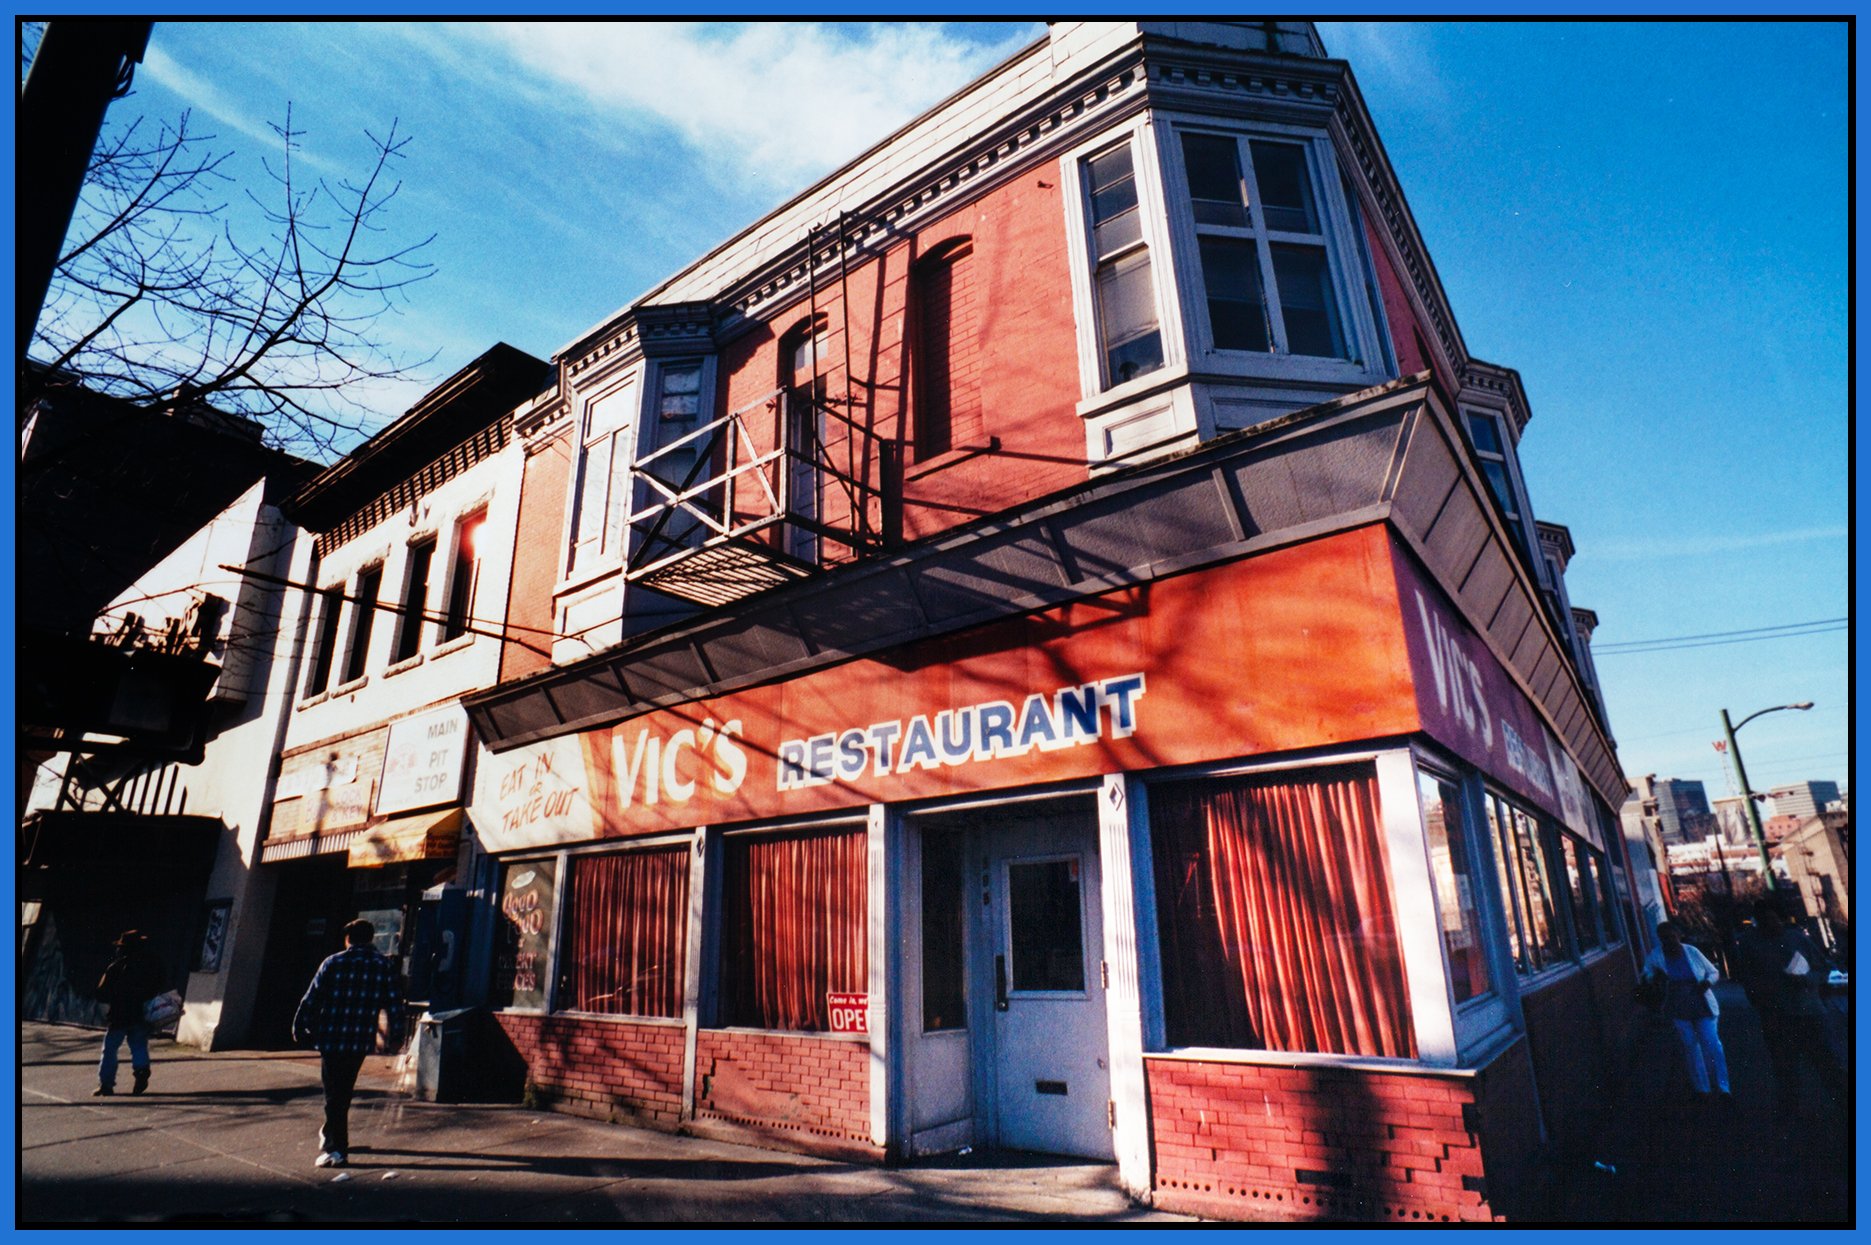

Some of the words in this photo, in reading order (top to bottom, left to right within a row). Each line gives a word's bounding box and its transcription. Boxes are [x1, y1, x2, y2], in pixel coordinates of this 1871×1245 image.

[1414, 588, 1493, 750] VIC'S
[427, 718, 458, 740] MAIN
[611, 717, 747, 811] VIC'S
[776, 672, 1145, 792] RESTAURANT
[428, 749, 449, 769] PIT
[500, 763, 527, 801] EAT
[535, 751, 554, 780] IN
[414, 772, 448, 794] STOP
[529, 781, 543, 797] OR
[503, 796, 543, 834] TAKE
[544, 787, 580, 818] OUT
